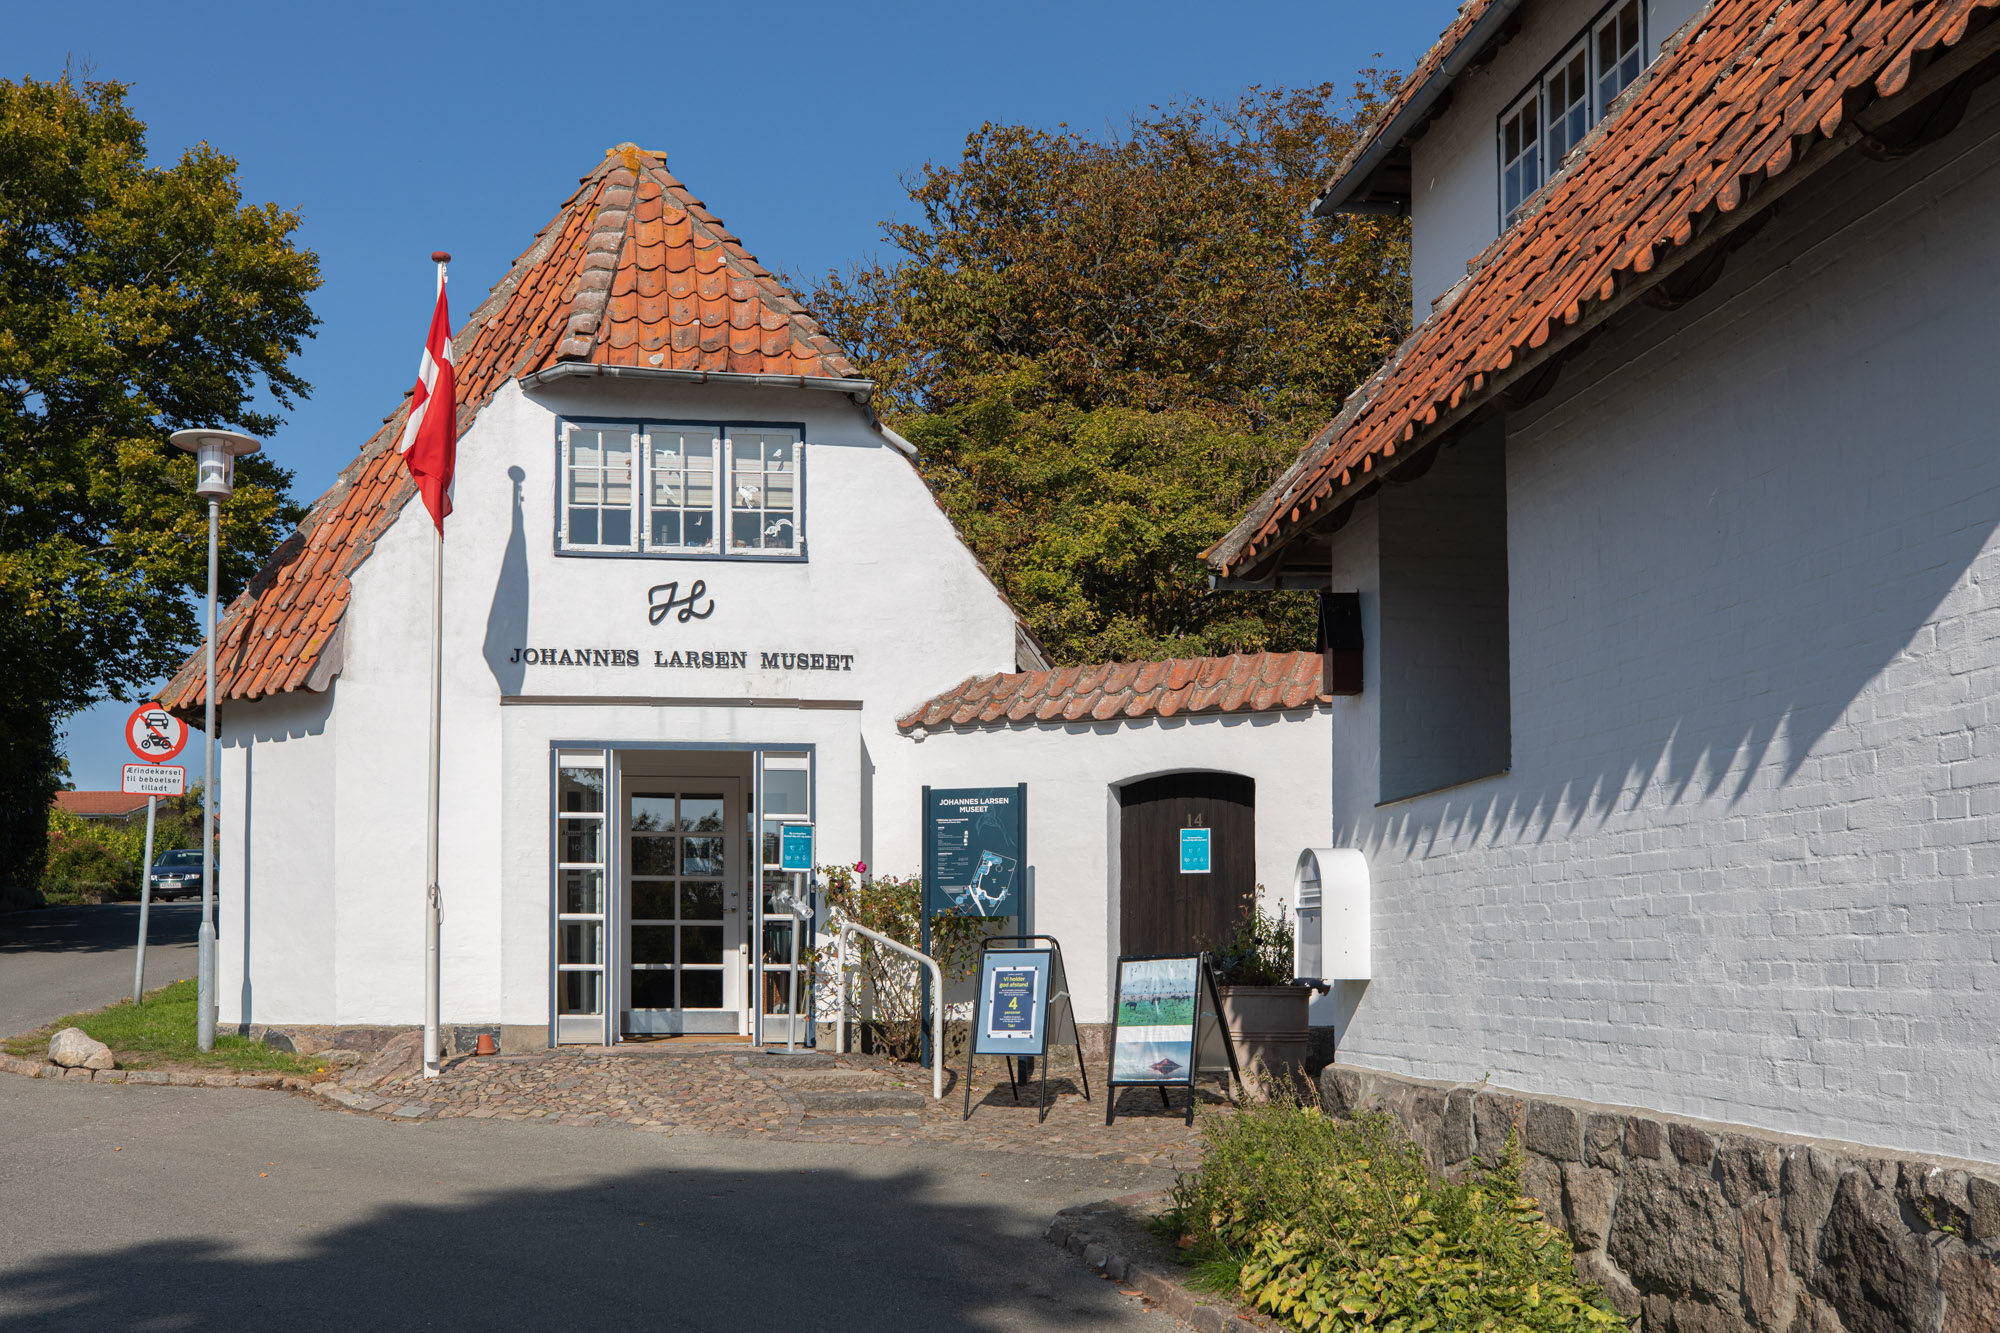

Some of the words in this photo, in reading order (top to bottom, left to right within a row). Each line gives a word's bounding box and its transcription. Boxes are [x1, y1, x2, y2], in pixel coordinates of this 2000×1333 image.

[510, 647, 640, 667] JOHANNES
[653, 650, 748, 670] LARSEN
[760, 652, 854, 672] MUSEET
[126, 767, 181, 776] Ærindekørsel
[139, 776, 181, 784] beboelser
[980, 797, 1009, 805] LARSEN
[1187, 813, 1203, 827] 14
[1009, 997, 1018, 1010] 4
